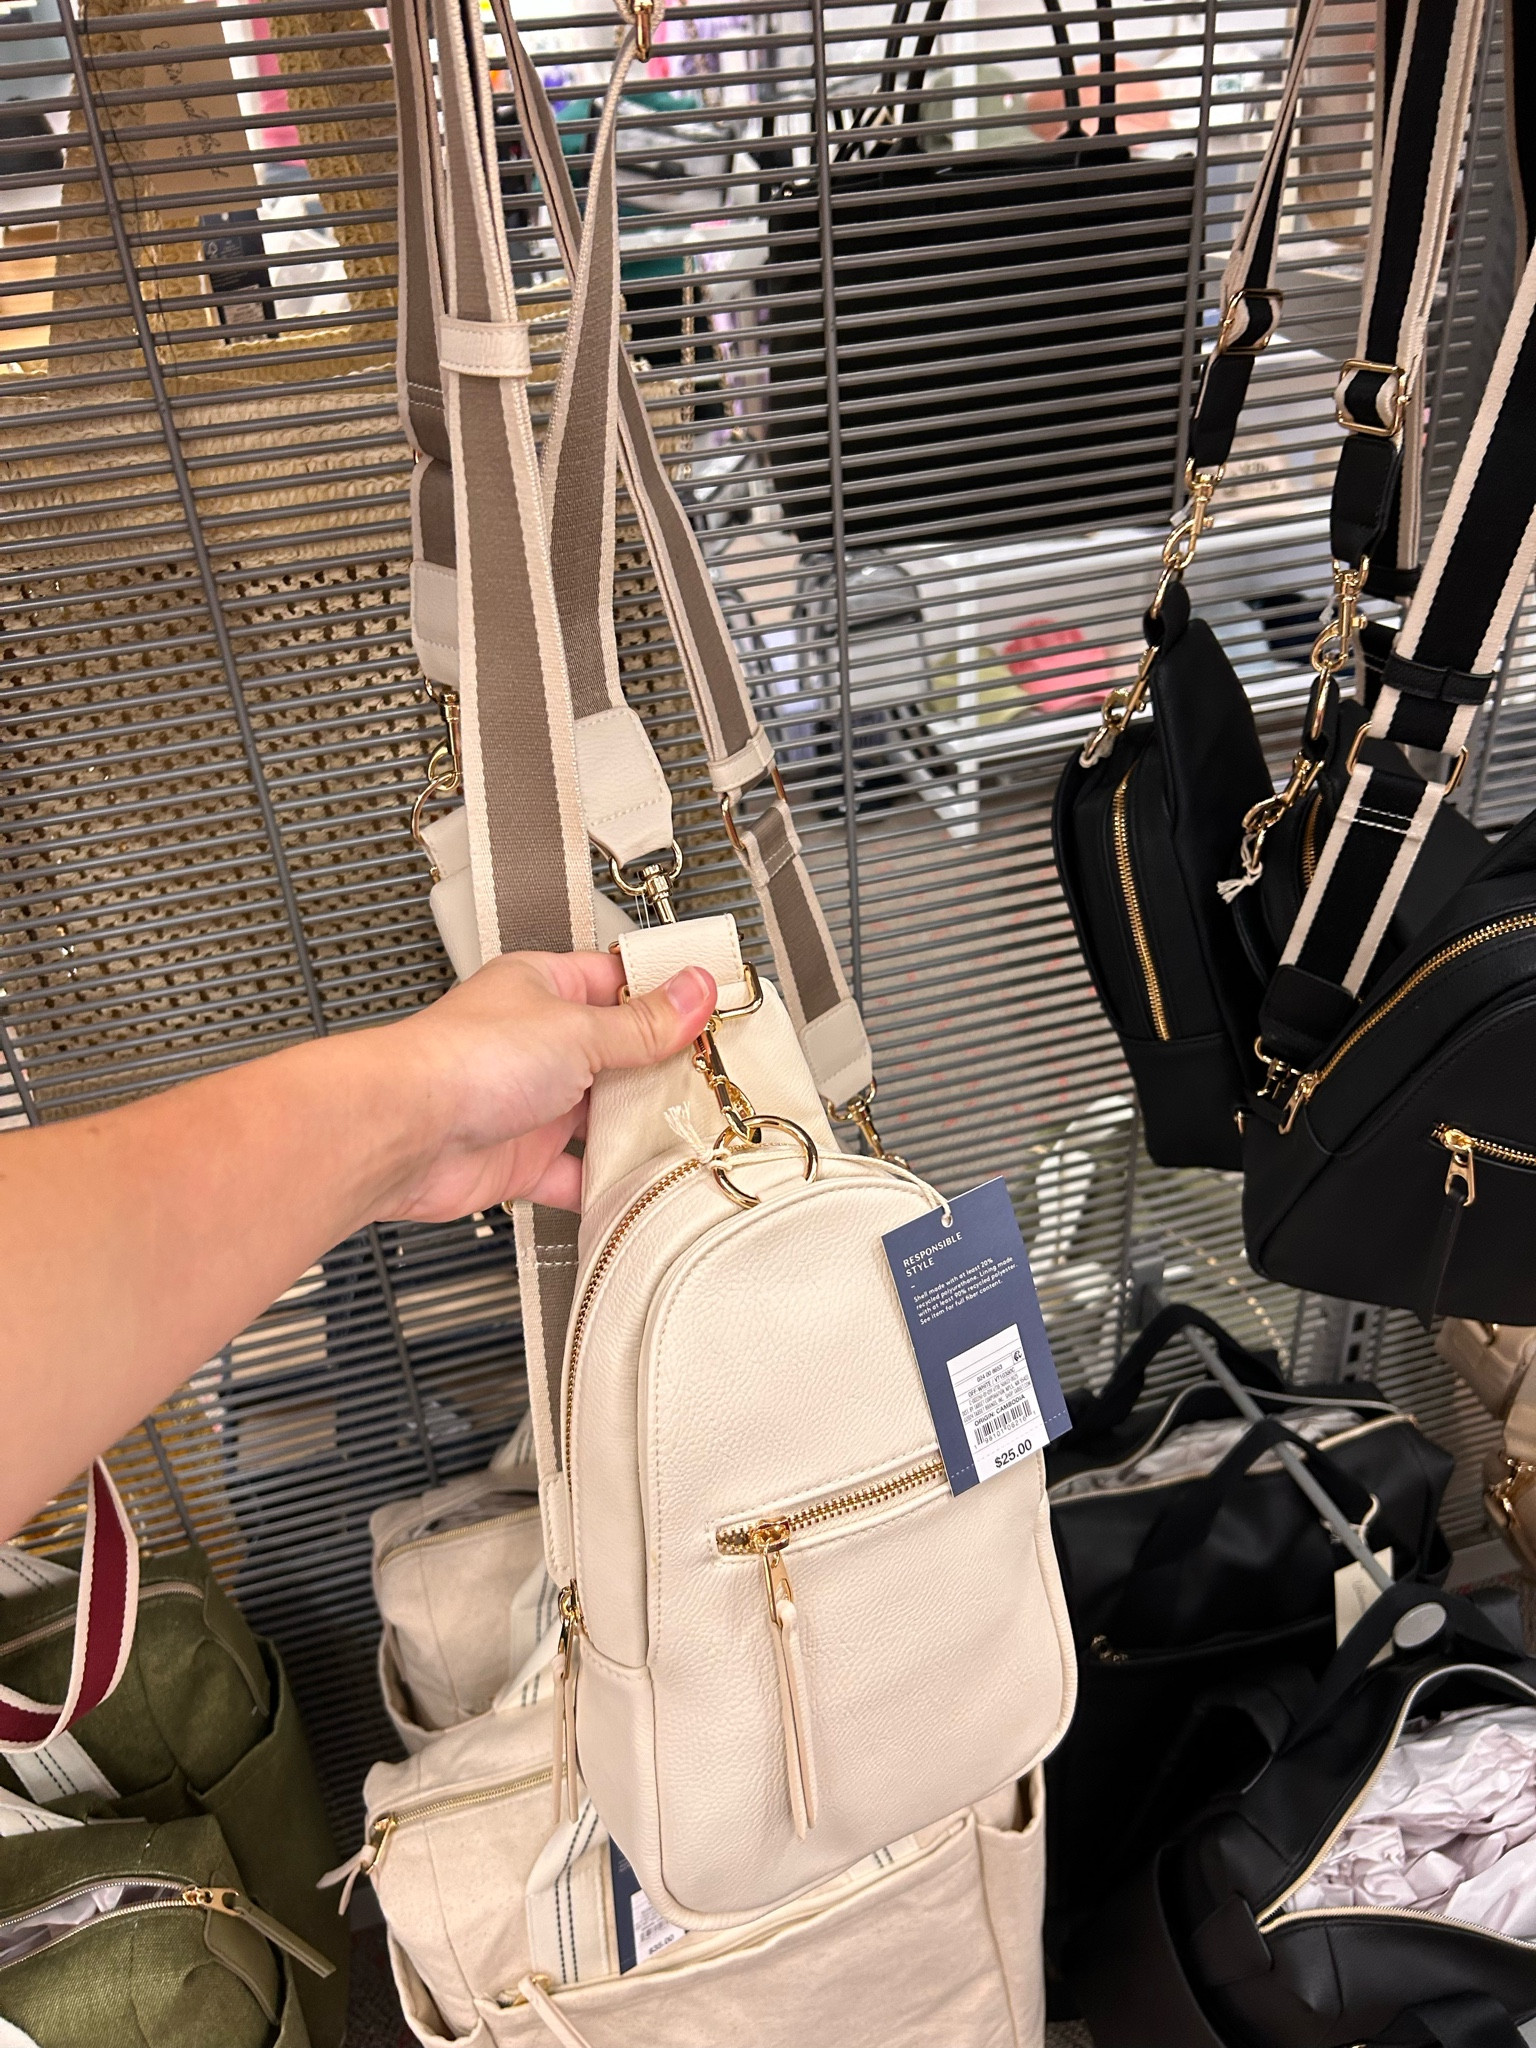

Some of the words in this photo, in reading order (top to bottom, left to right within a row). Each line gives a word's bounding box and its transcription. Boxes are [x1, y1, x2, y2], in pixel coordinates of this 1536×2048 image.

[903, 1232, 962, 1267] RESPONSIBLE
[906, 1257, 934, 1277] STYLE
[914, 1291, 928, 1303] Shell
[929, 1283, 945, 1295] made
[946, 1276, 958, 1285] with
[966, 1265, 981, 1275] least
[980, 1258, 993, 1268] 20%
[916, 1295, 940, 1310] recycled
[941, 1275, 978, 1300] polyurethane.
[980, 1266, 997, 1277] Lining
[998, 1257, 1013, 1268] made
[918, 1306, 931, 1317] with
[940, 1296, 954, 1305] least
[968, 1277, 990, 1292] recycled
[991, 1264, 1018, 1281] polyester.
[920, 1316, 931, 1325] See
[931, 1309, 945, 1319] item
[945, 1304, 954, 1312] for
[955, 1298, 965, 1307] full
[966, 1292, 978, 1301] fiber
[979, 1280, 1003, 1294] content.
[973, 1410, 995, 1426] ORIGIN:
[995, 1393, 1025, 1414] CAMBODIA
[994, 1438, 1032, 1468] $25.00
